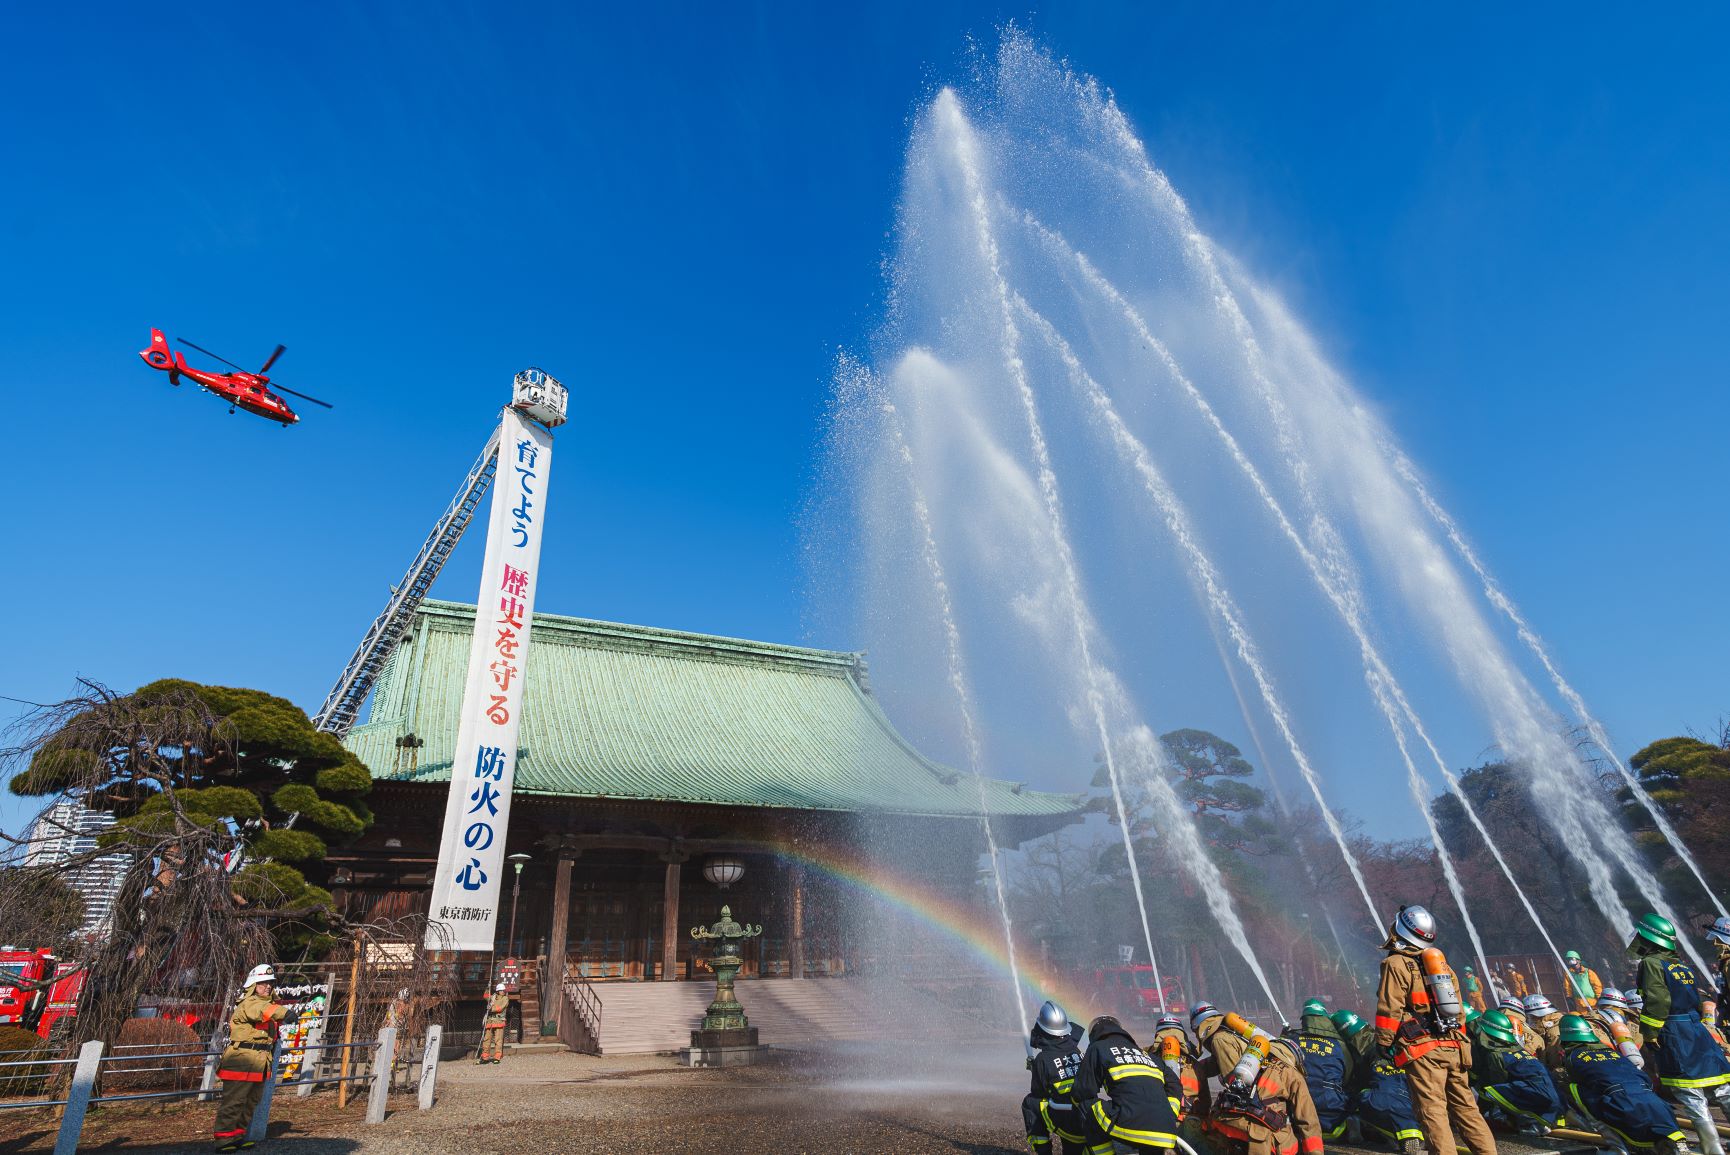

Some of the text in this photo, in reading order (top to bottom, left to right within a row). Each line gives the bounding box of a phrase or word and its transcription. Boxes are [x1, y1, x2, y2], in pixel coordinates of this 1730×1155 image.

[455, 438, 539, 891] 育てよう 歴史を守る 防火の心
[438, 906, 492, 922] 東京消防庁
[1305, 1048, 1326, 1057] TOKYO
